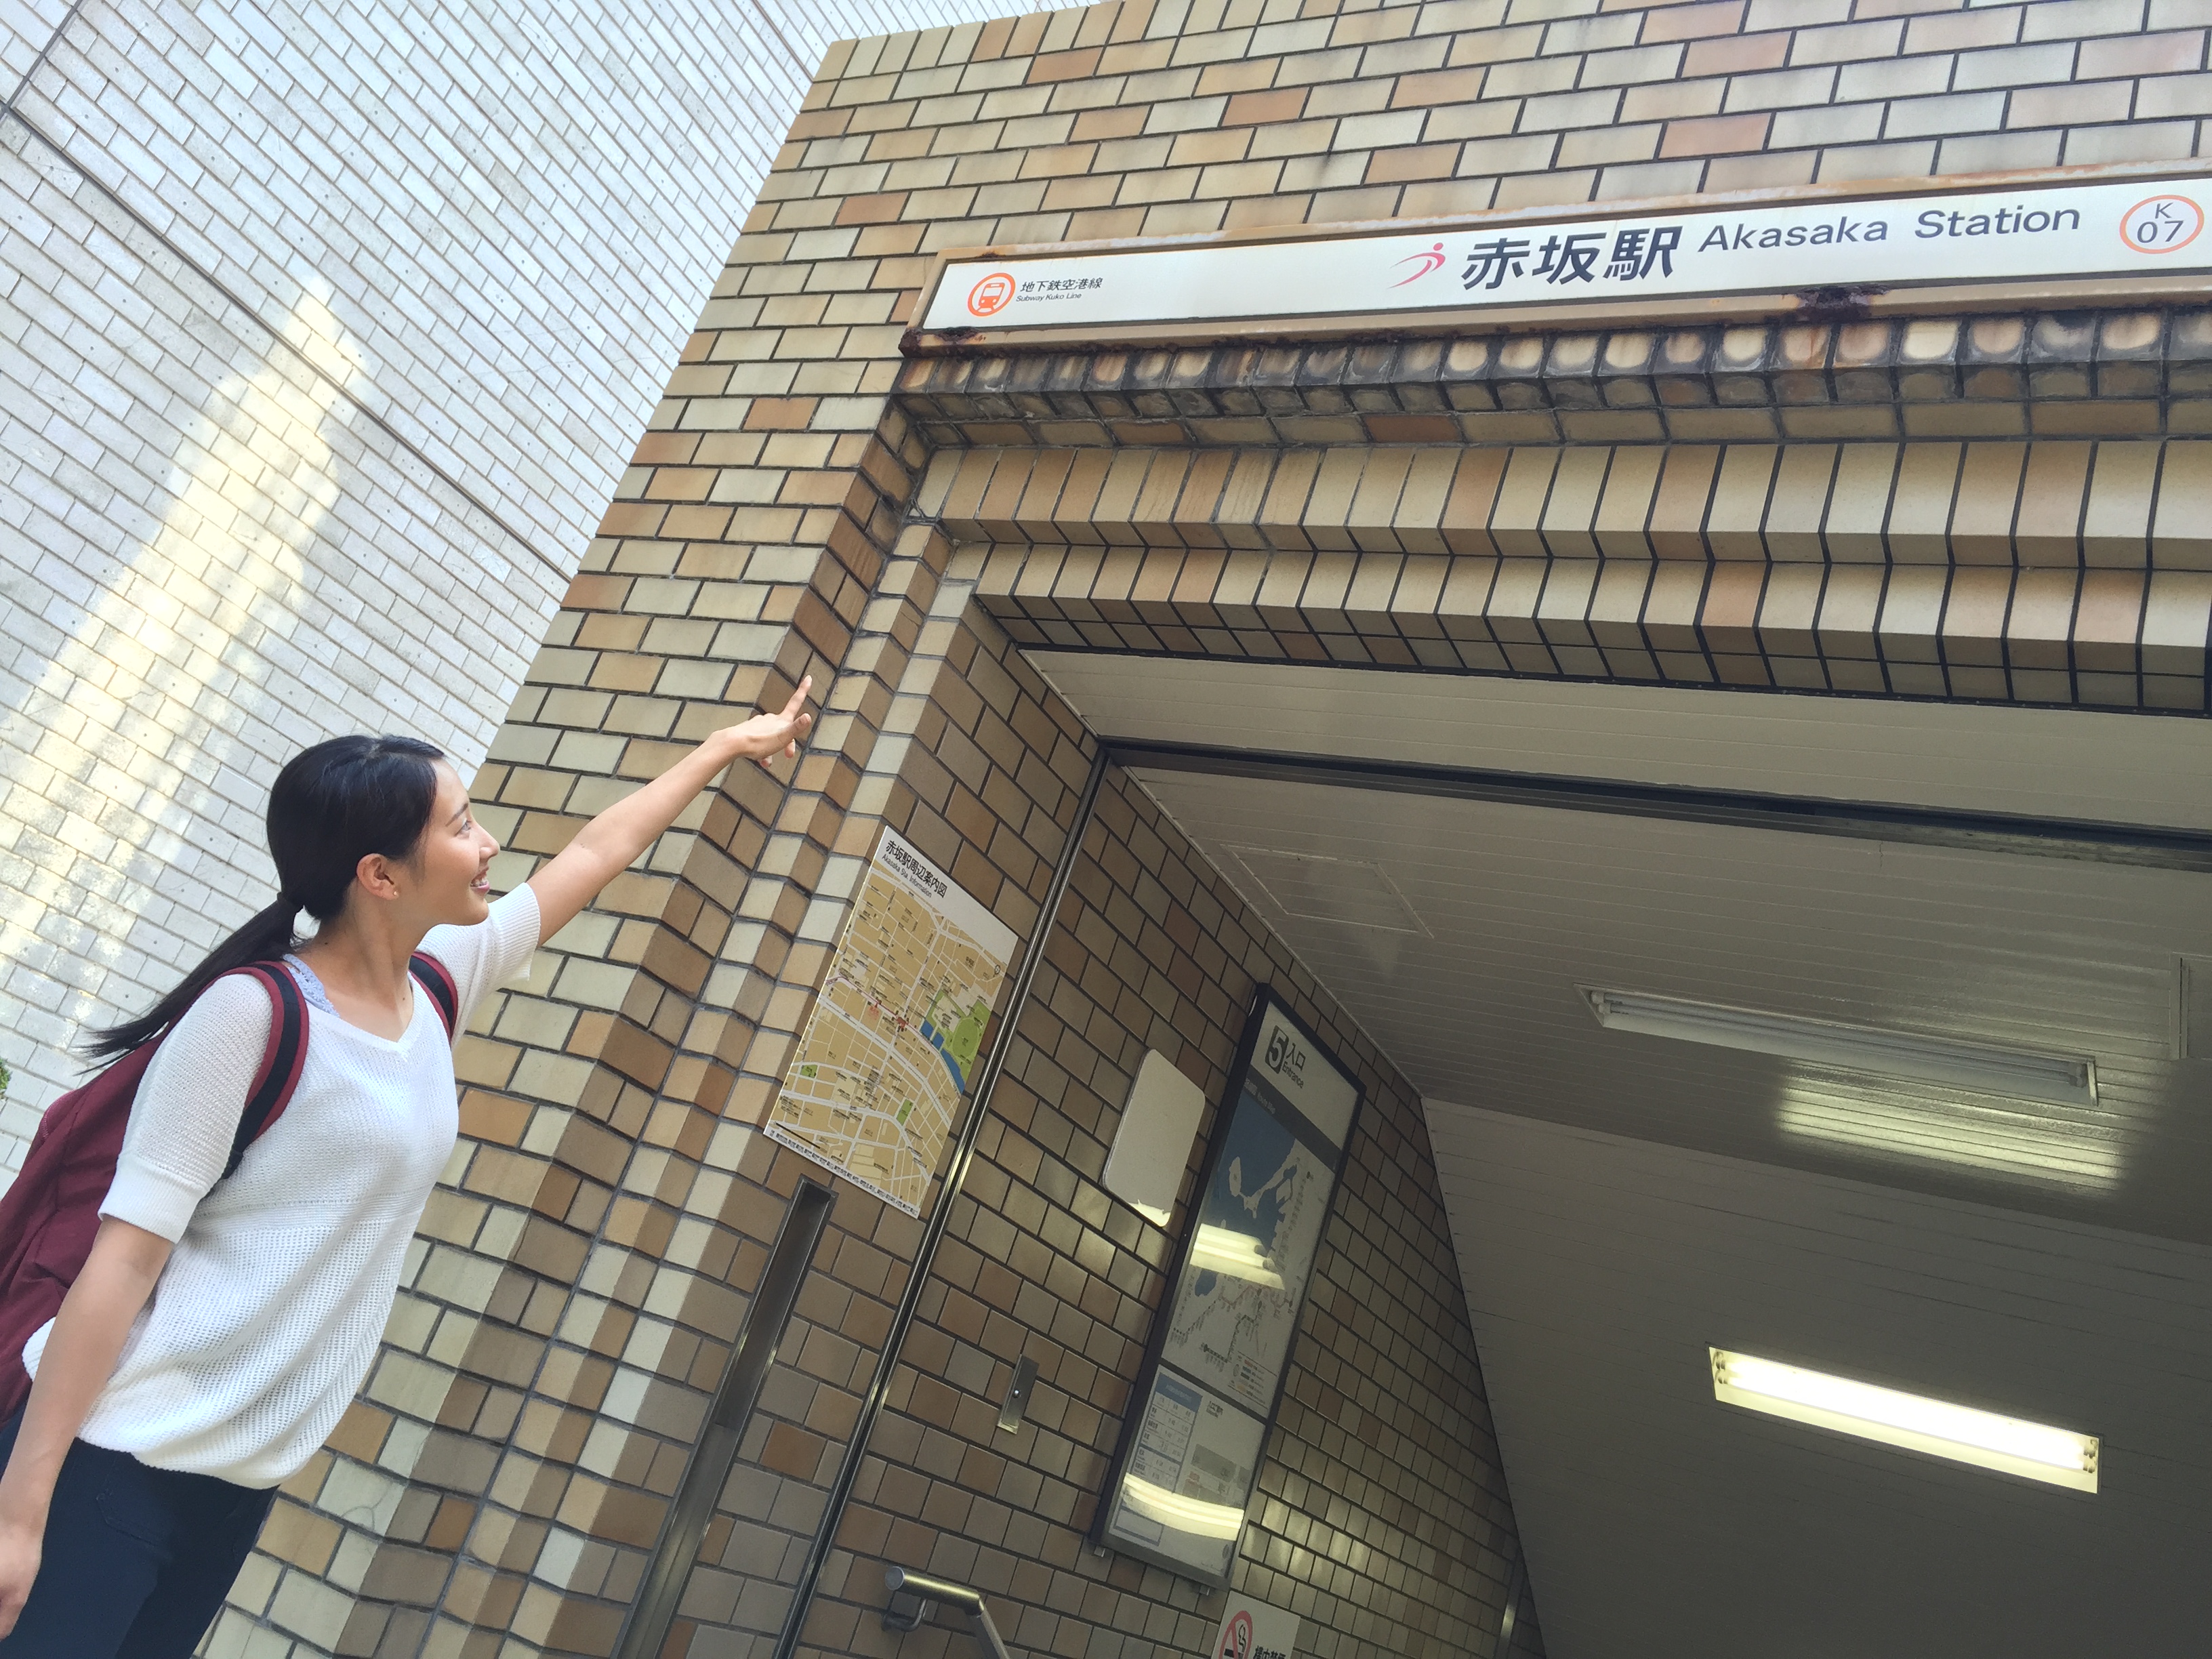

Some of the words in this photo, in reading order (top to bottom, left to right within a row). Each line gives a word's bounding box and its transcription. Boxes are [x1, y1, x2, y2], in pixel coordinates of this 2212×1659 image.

[2155, 203, 2173, 219] K
[1698, 216, 1888, 252] Akasaka
[1914, 205, 2080, 238] Station
[2137, 220, 2184, 243] 07
[1461, 226, 1683, 290] 赤坂駅
[1020, 277, 1103, 293] 地下鉄空港線
[882, 854, 901, 873] Akasaka
[909, 875, 933, 898] Information
[886, 840, 947, 898] 赤坂駅周辺案内図
[1268, 1029, 1287, 1069] 5
[1286, 1043, 1306, 1071] 入口
[1282, 1061, 1304, 1088] Entrance
